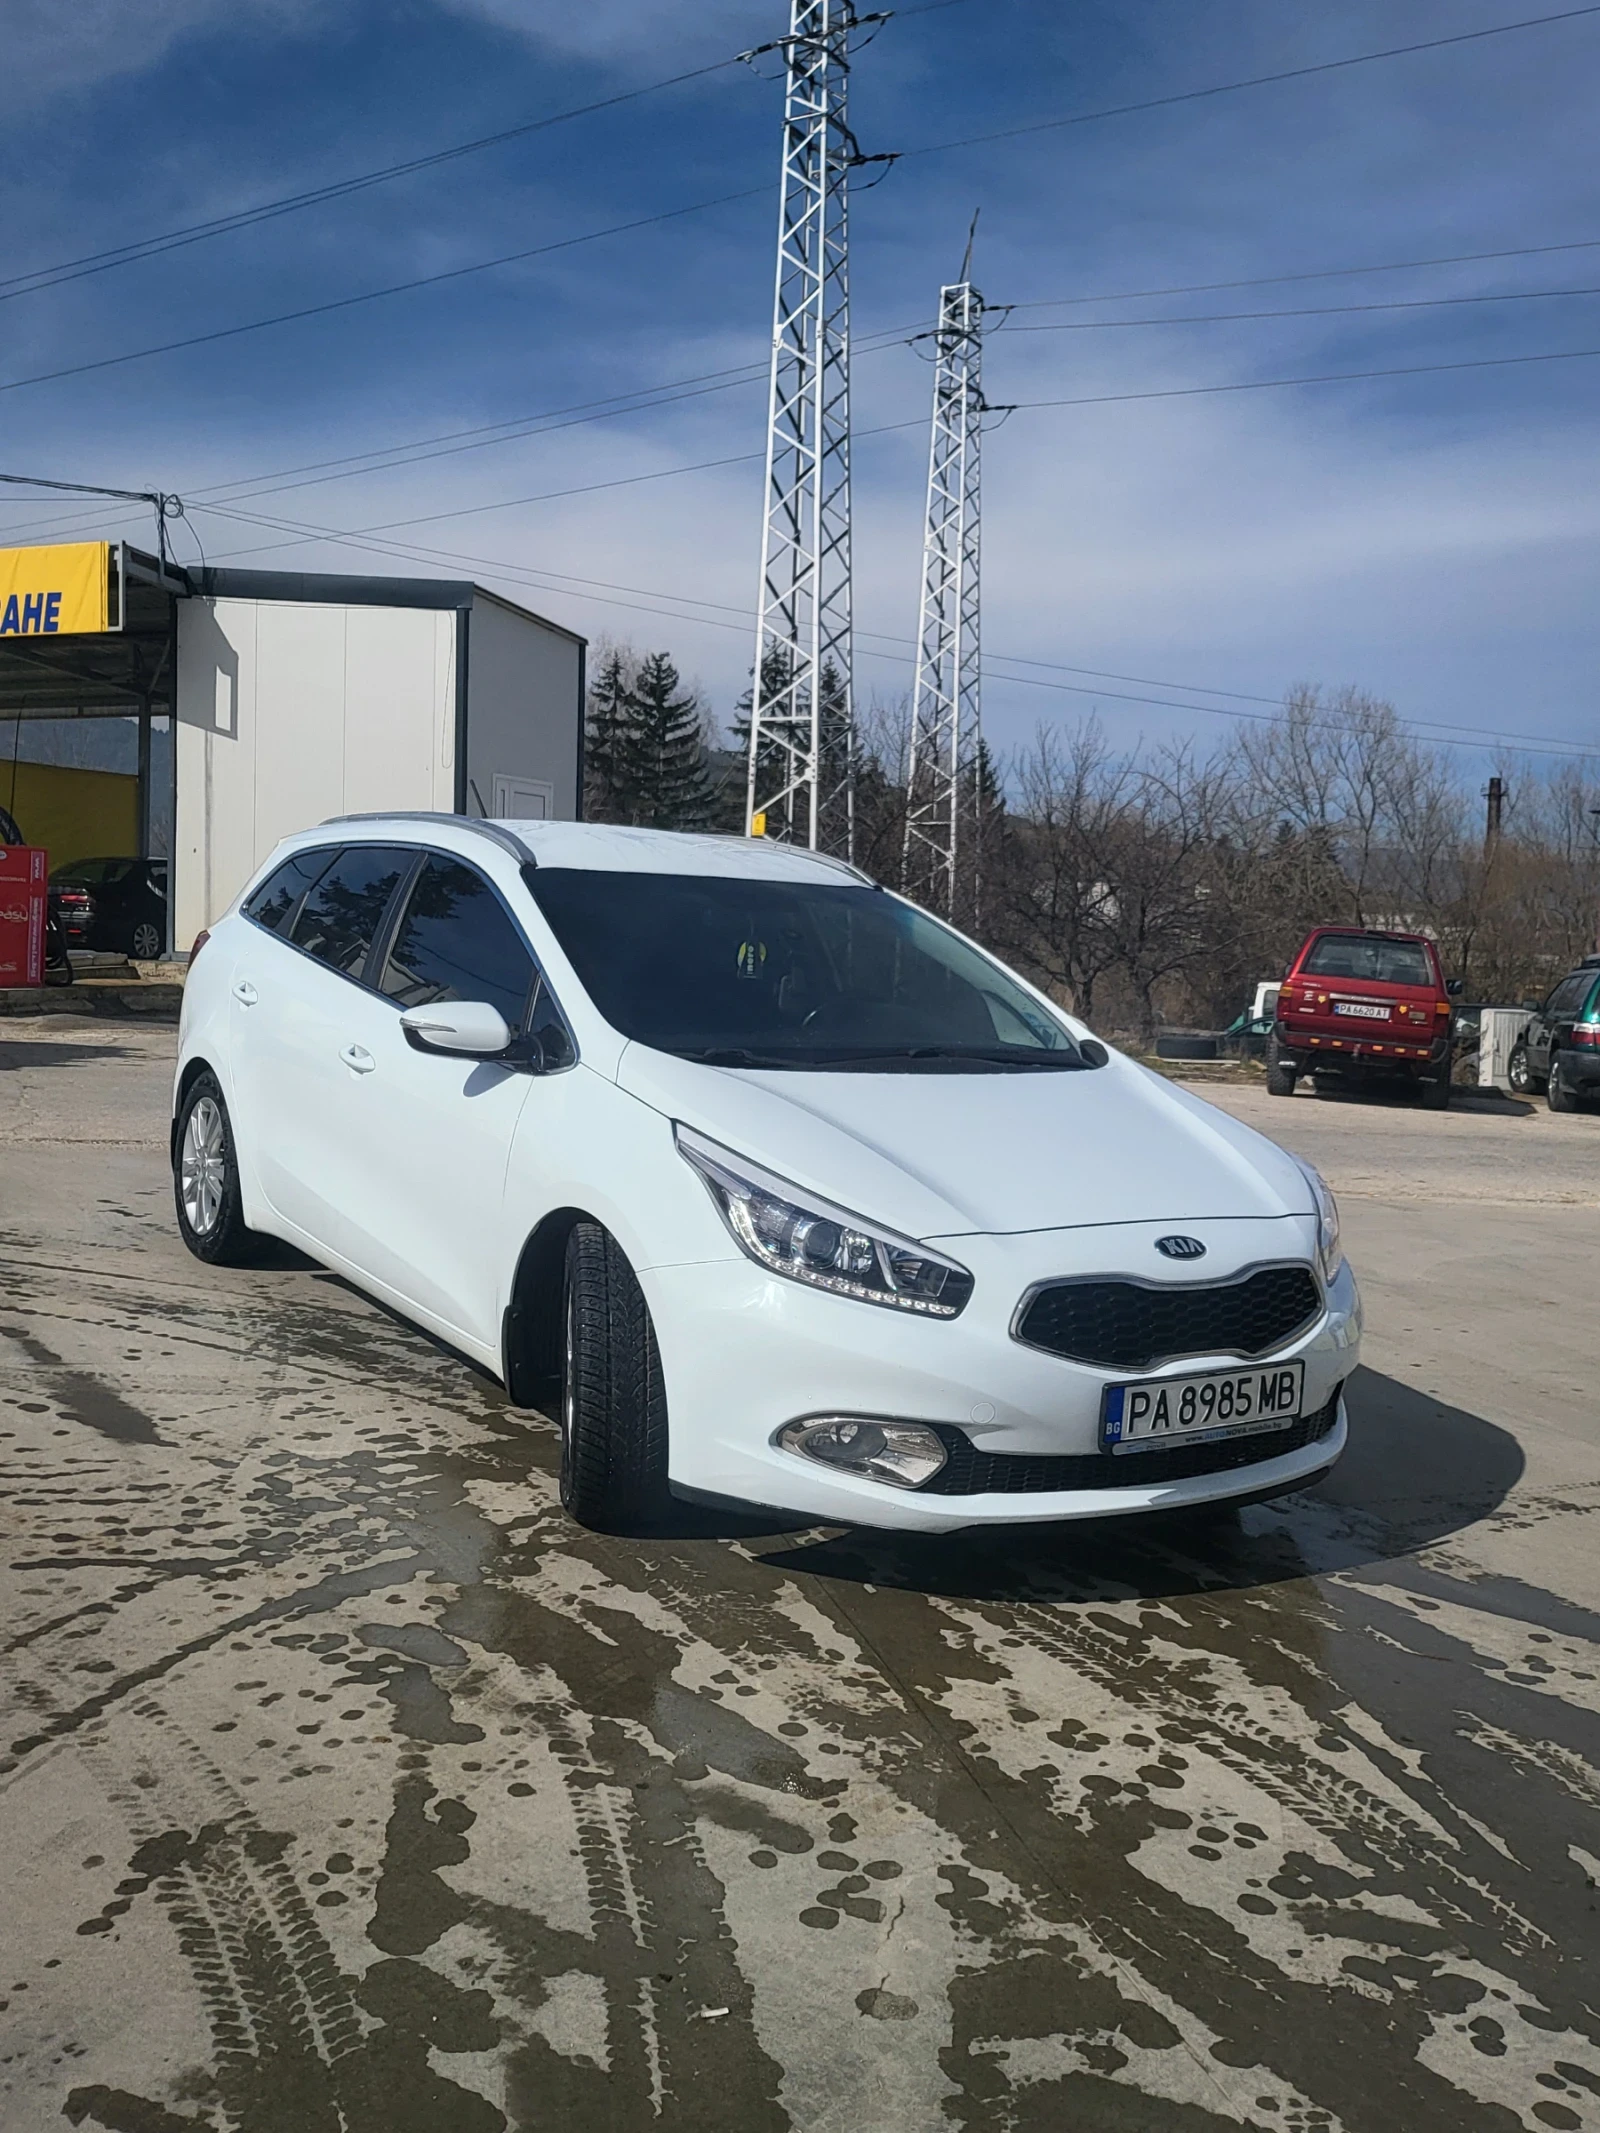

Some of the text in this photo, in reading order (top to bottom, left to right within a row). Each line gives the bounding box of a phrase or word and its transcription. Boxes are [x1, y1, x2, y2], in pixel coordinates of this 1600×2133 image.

[0, 592, 62, 634] АНЕ
[1340, 1004, 1388, 1018] PA 6620 AT
[1162, 1238, 1203, 1255] KIA
[1127, 1371, 1295, 1434] PA 8985 MB
[1106, 1422, 1121, 1434] BG
